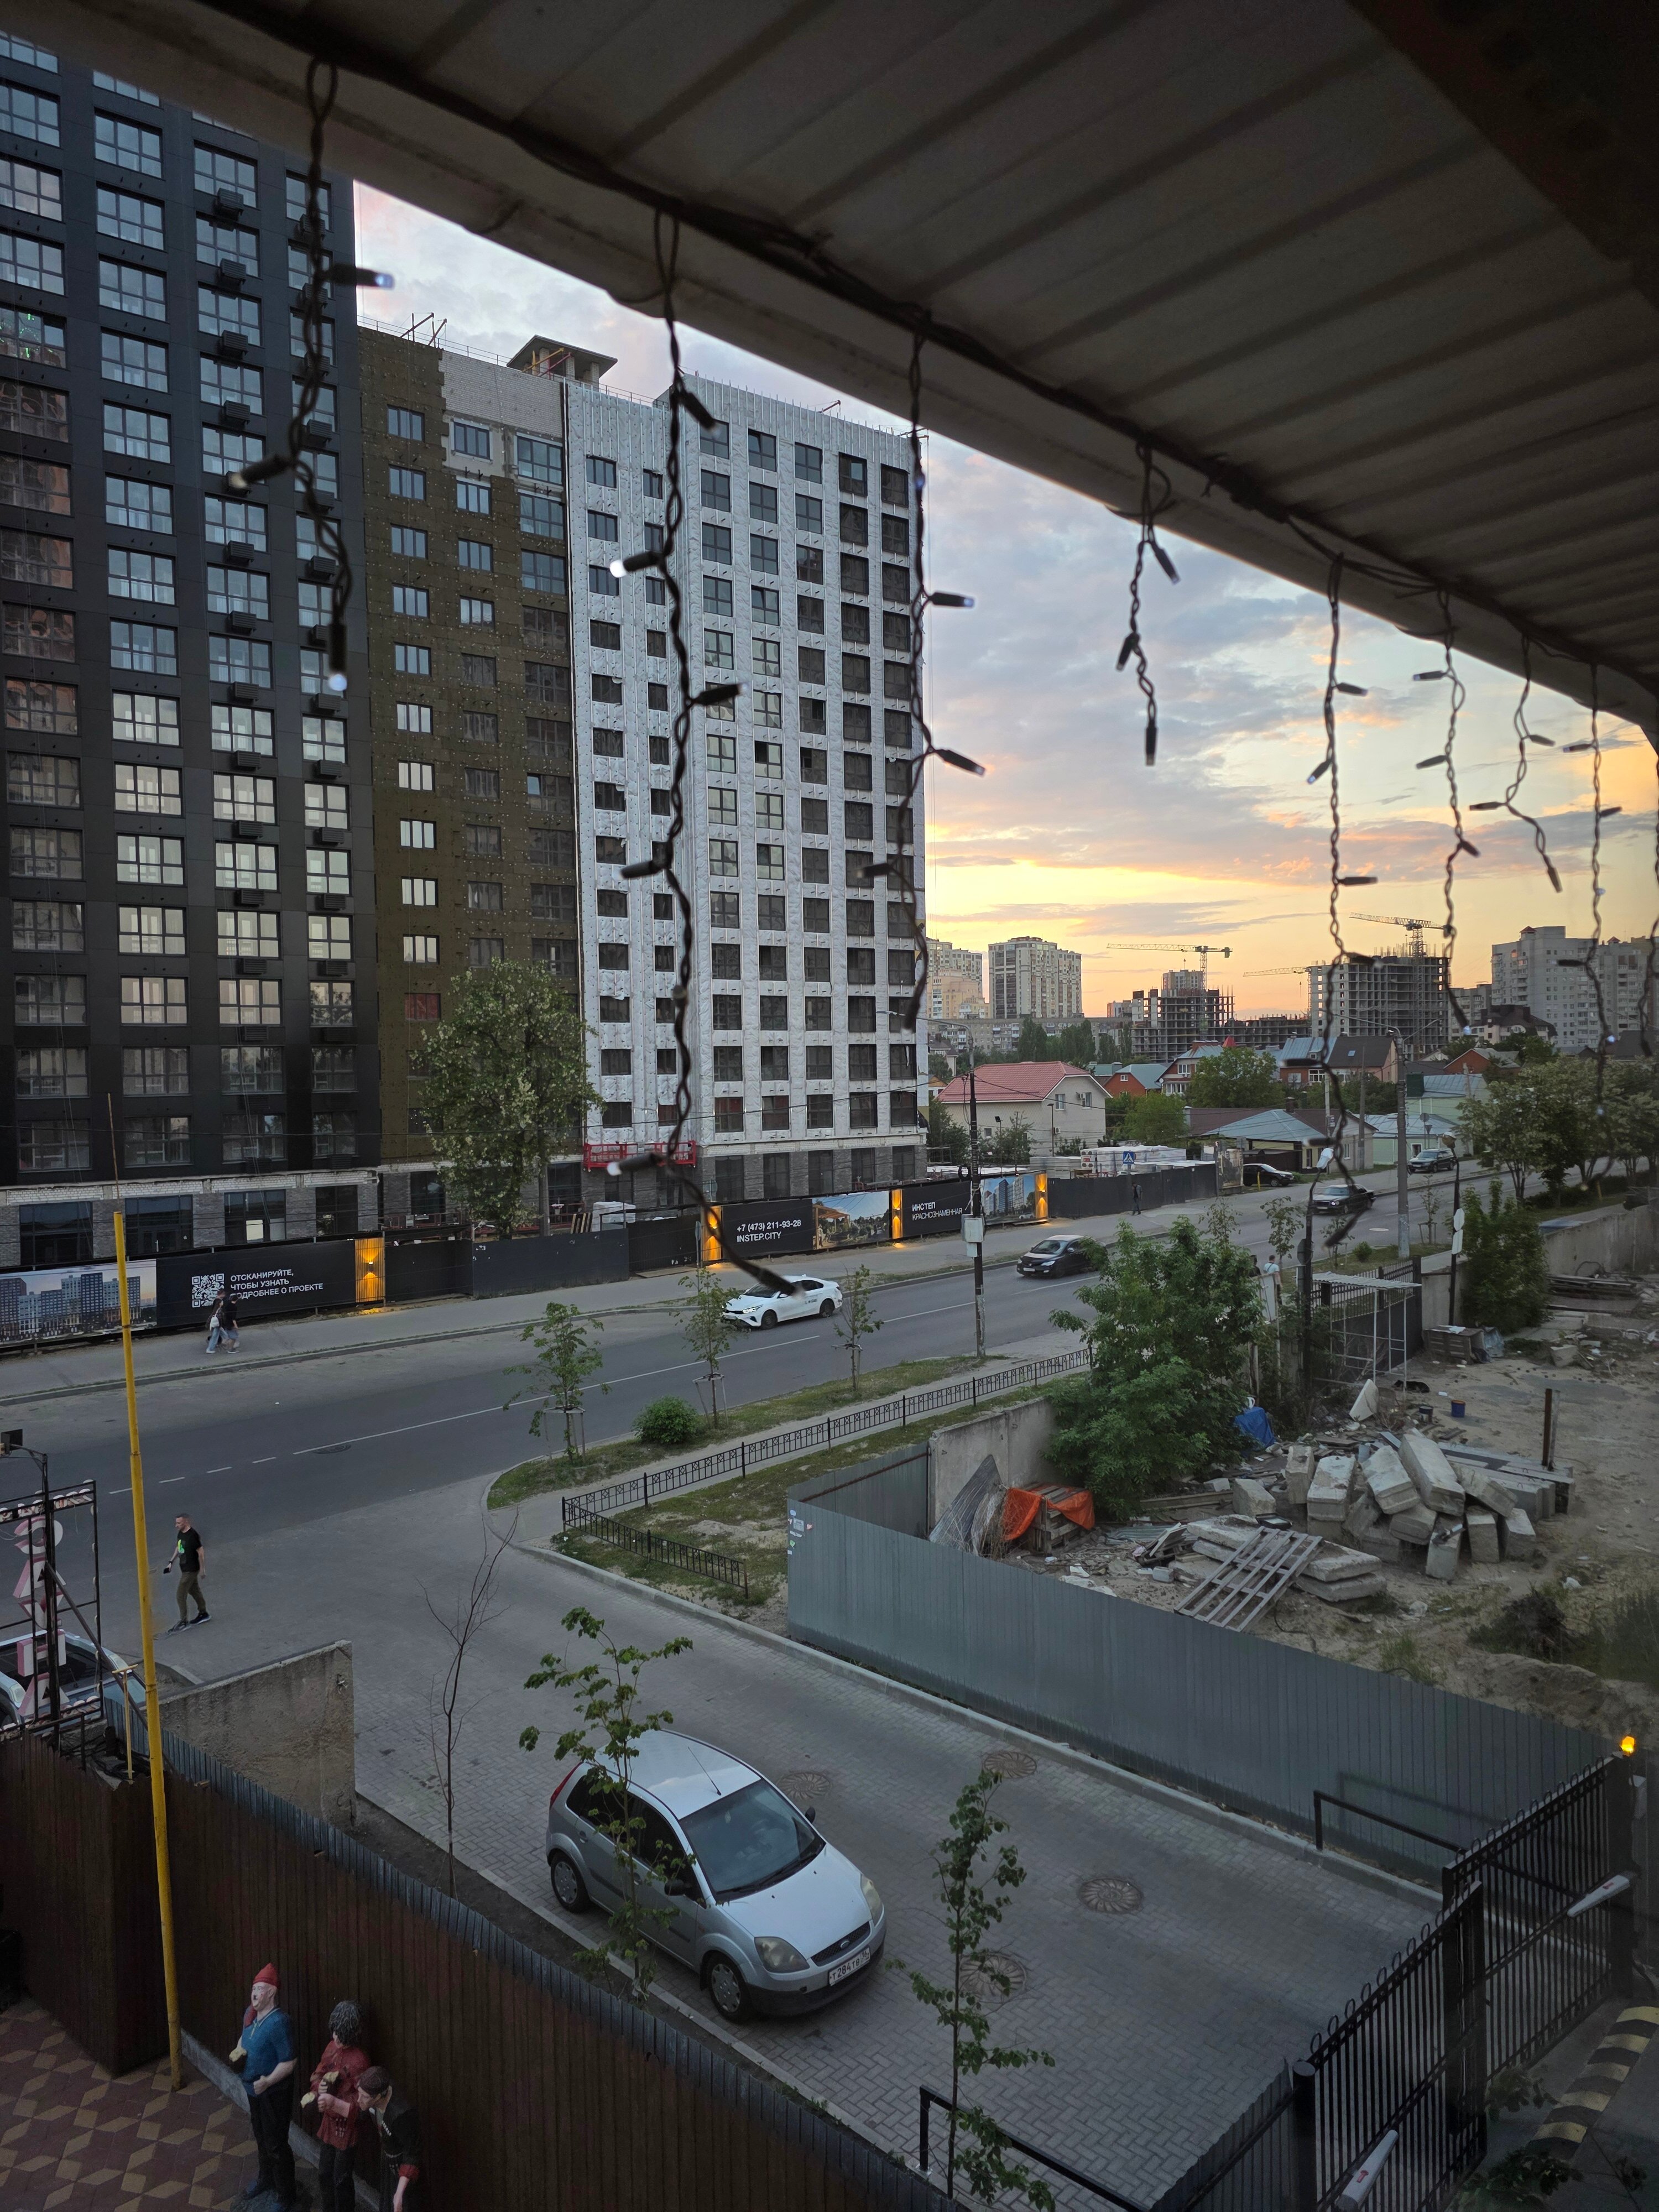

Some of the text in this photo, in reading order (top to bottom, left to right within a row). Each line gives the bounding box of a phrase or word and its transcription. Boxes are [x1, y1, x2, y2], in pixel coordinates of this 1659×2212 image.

[912, 1202, 936, 1212] ИНСТЕП
[912, 1207, 963, 1221] КРАСНОЗНАМЕННАЯ
[737, 1219, 802, 1233] +7 (473) 211-93-28
[737, 1231, 781, 1243] INSTEP.CITY
[230, 1269, 294, 1282] ОТСКАНИРУЙТЕ,
[230, 1278, 290, 1291] ЧТОБЫ УЗНАТЬ
[289, 1283, 324, 1293] ПРОЕКТЕ
